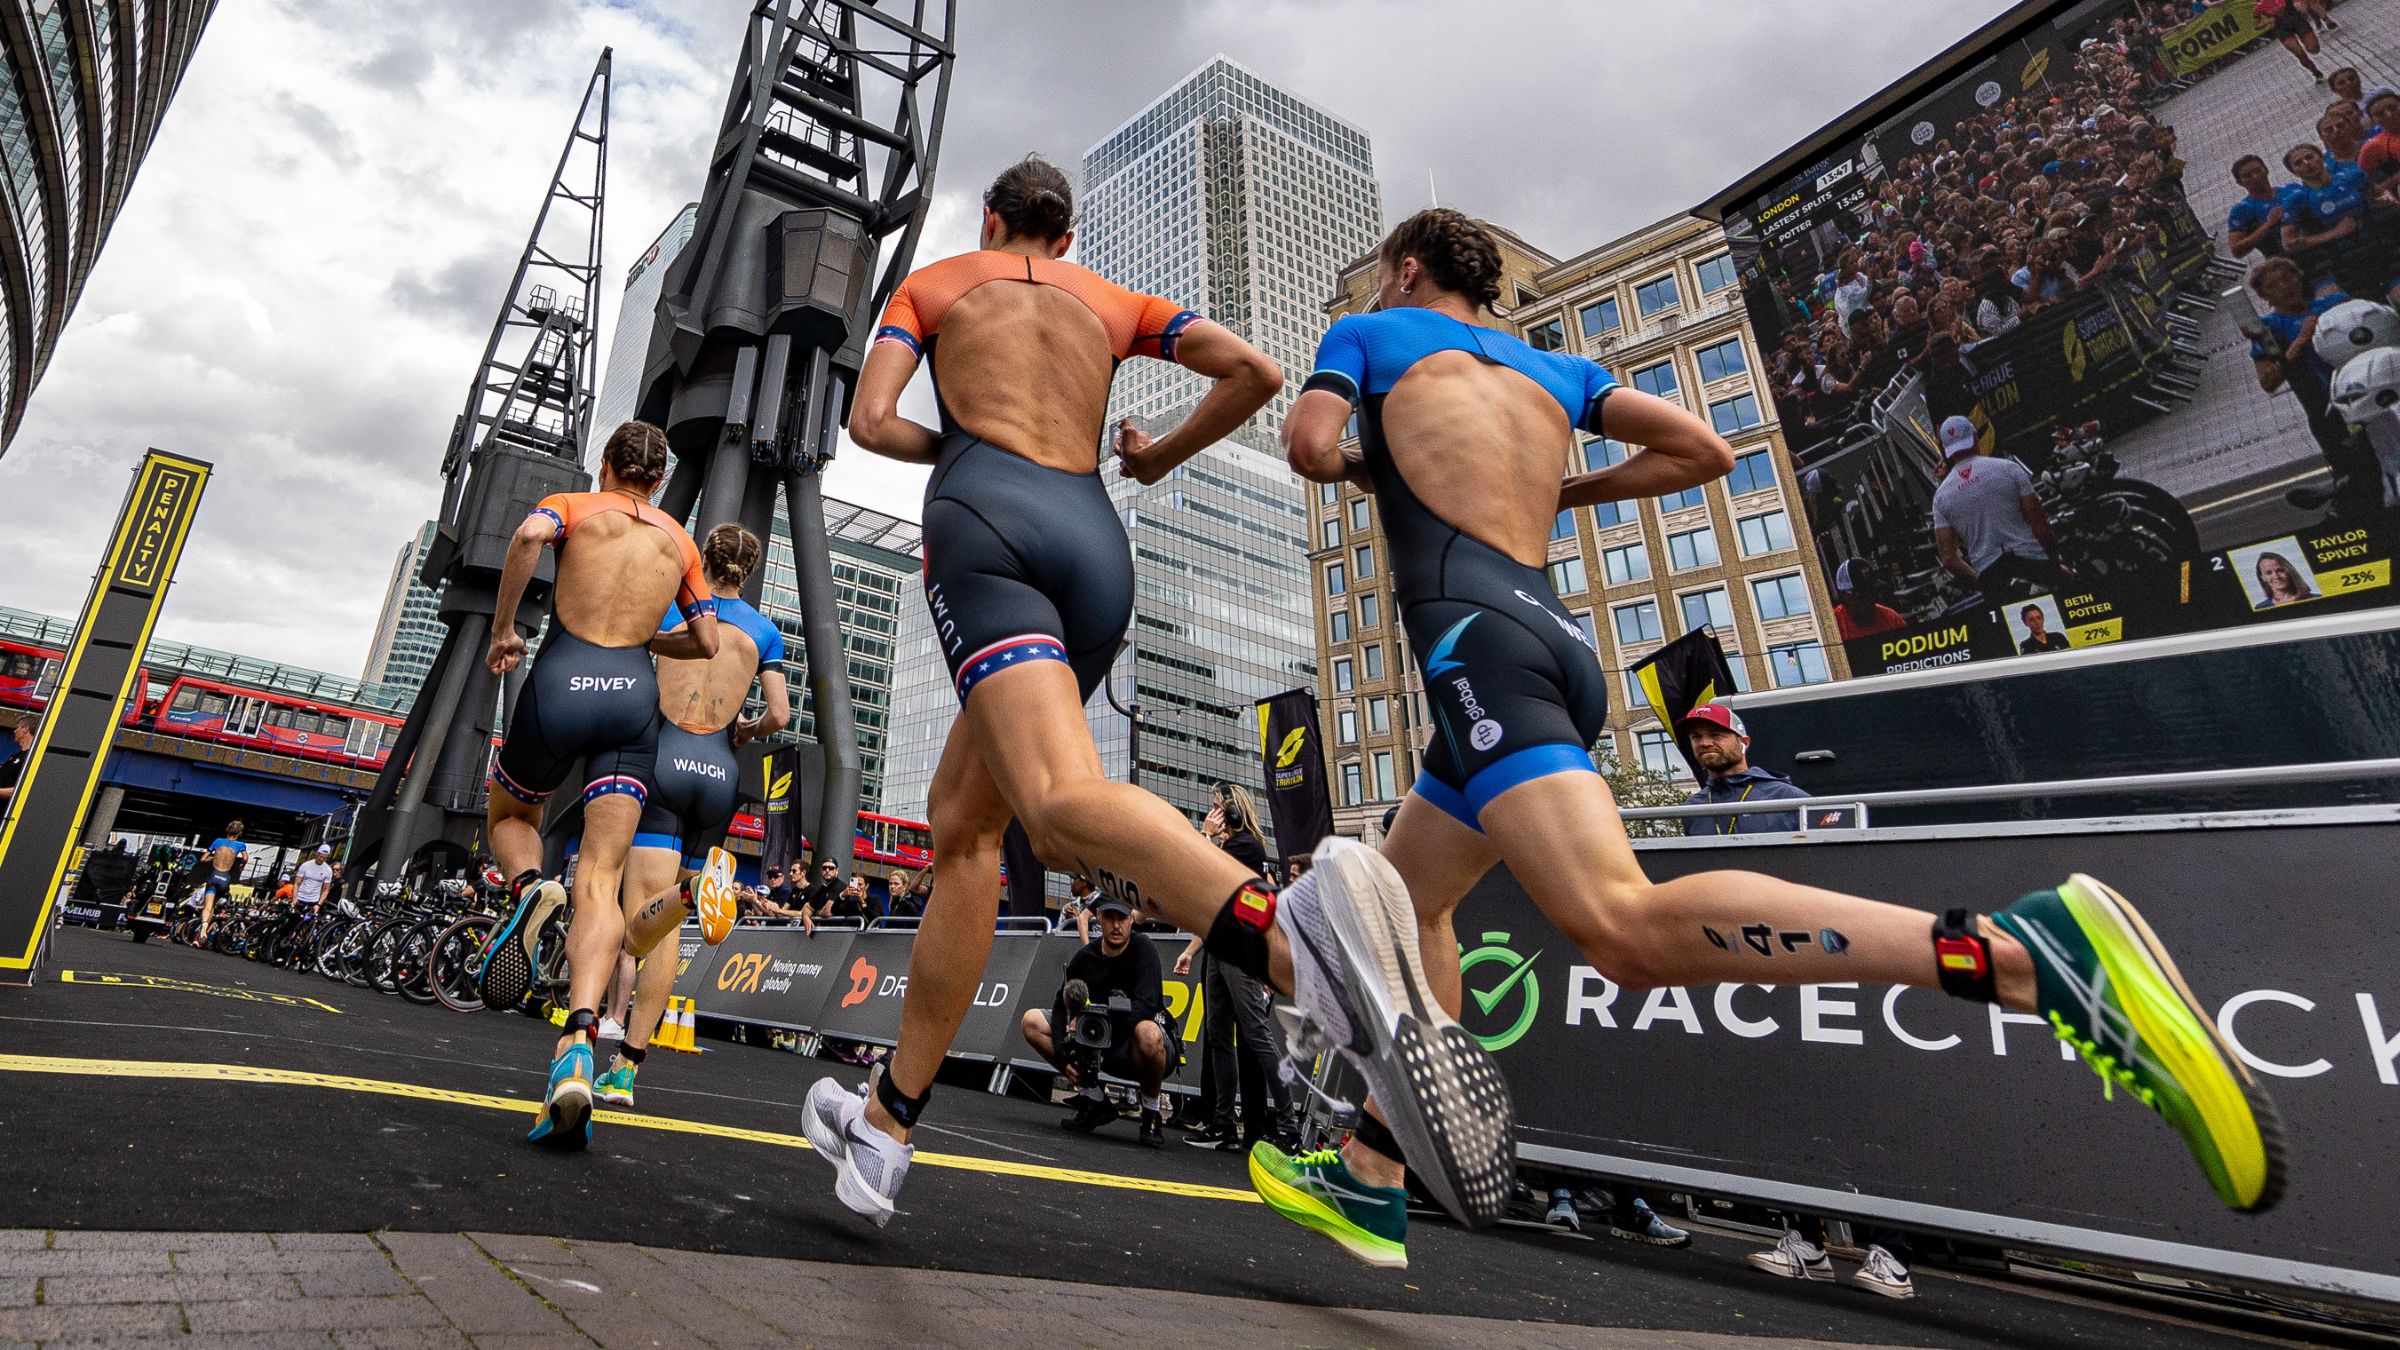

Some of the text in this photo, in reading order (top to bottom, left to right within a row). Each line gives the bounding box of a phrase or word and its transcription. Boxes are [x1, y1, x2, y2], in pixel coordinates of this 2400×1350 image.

[2168, 13, 2240, 66] FORM
[1757, 193, 1800, 223] LONDON
[1822, 163, 1849, 185] 13:47
[1763, 190, 1833, 236] LASTEST SPLITS
[1778, 219, 1812, 243] POTTER
[1836, 188, 1866, 210] 13:45
[1972, 360, 2015, 396] EAGUE
[134, 478, 178, 577] PENALTY
[2210, 528, 2368, 572] 2 TAYLOR
[2316, 543, 2369, 564] SPIVEY
[2340, 570, 2376, 588] 23%
[1989, 593, 2095, 623] 1 BETH
[2068, 602, 2113, 620] POTTER
[1882, 624, 1969, 661] PODIUM
[2084, 626, 2111, 641] 27%
[1886, 648, 1971, 674] PREDICTIONS
[569, 676, 637, 692] SPIVEY
[1452, 676, 1486, 721] global
[673, 758, 726, 782] WAUGH
[717, 952, 823, 994] OFX Moving money
[760, 975, 792, 995] globally
